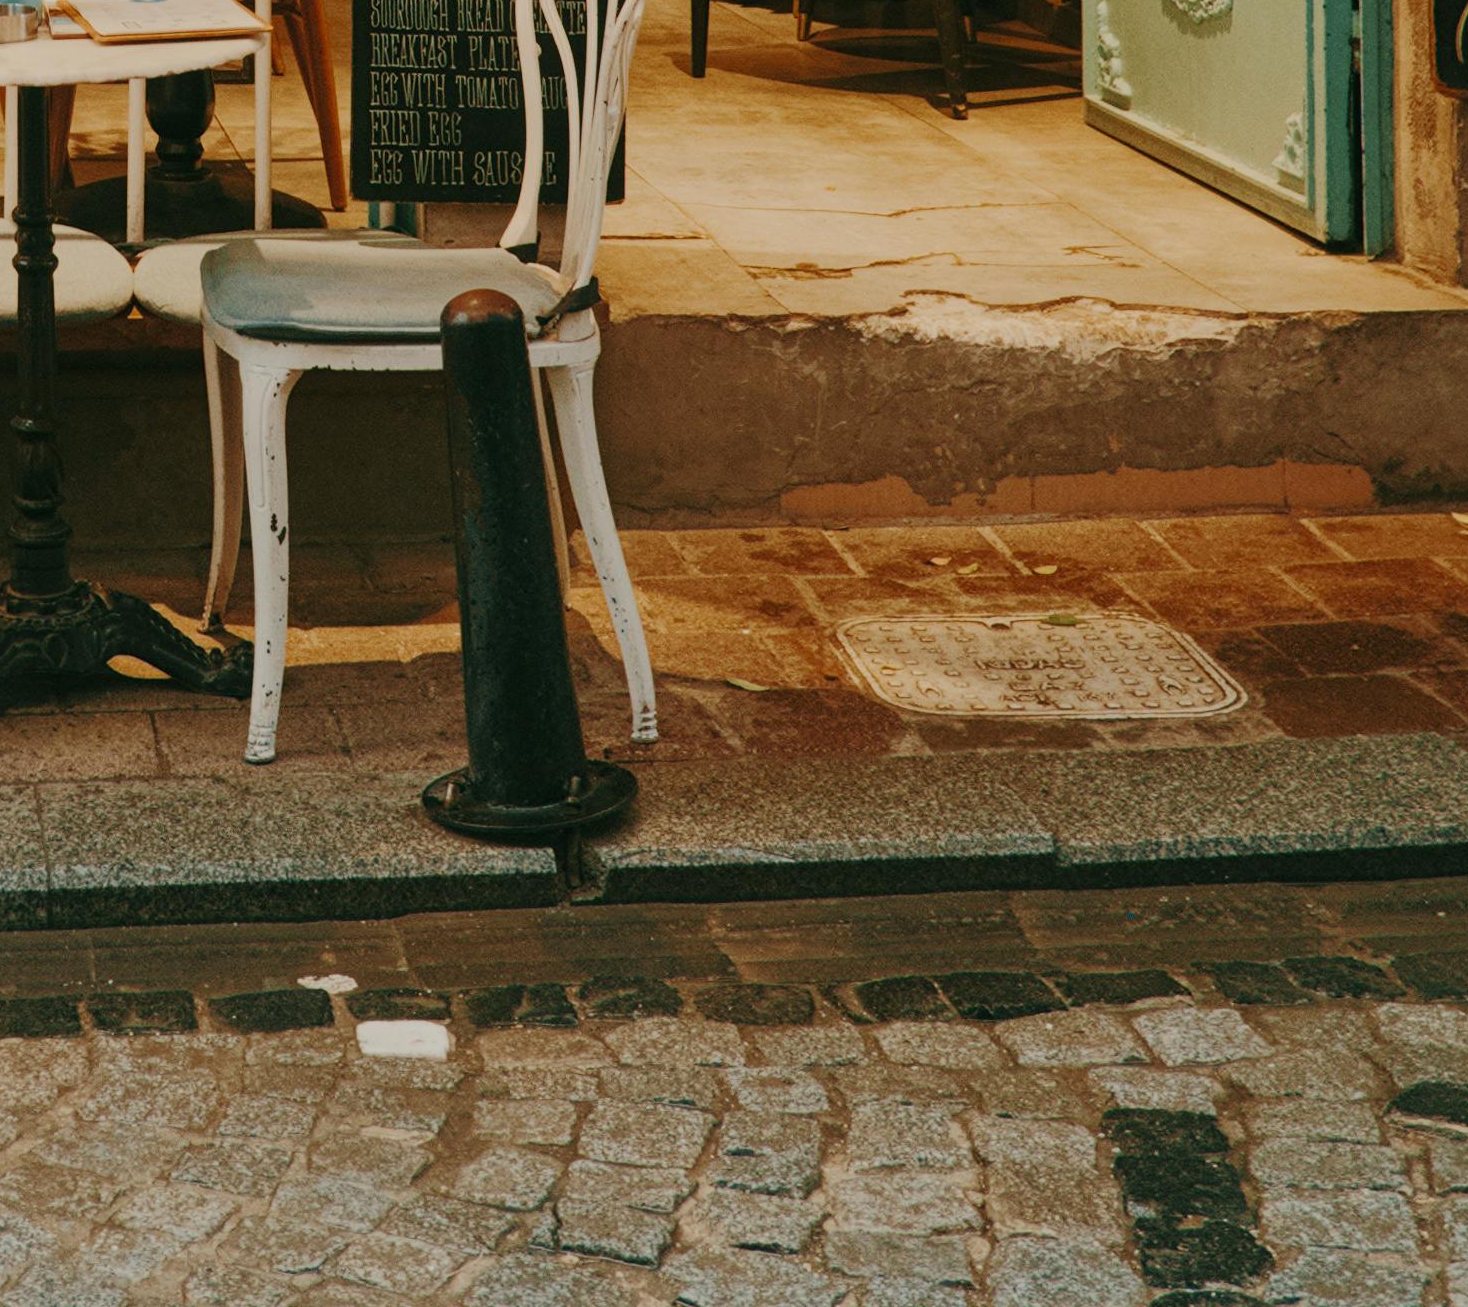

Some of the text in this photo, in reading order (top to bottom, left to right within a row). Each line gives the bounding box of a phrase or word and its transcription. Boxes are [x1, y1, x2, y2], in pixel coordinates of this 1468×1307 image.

[370, 33, 520, 71] BREAKFAST PLATE
[370, 71, 398, 106] EGG
[403, 73, 446, 109] WITH
[455, 75, 519, 110] TOMATO
[369, 109, 462, 146] FRIED EGG
[369, 149, 557, 186] EGG WITH SAUSE
